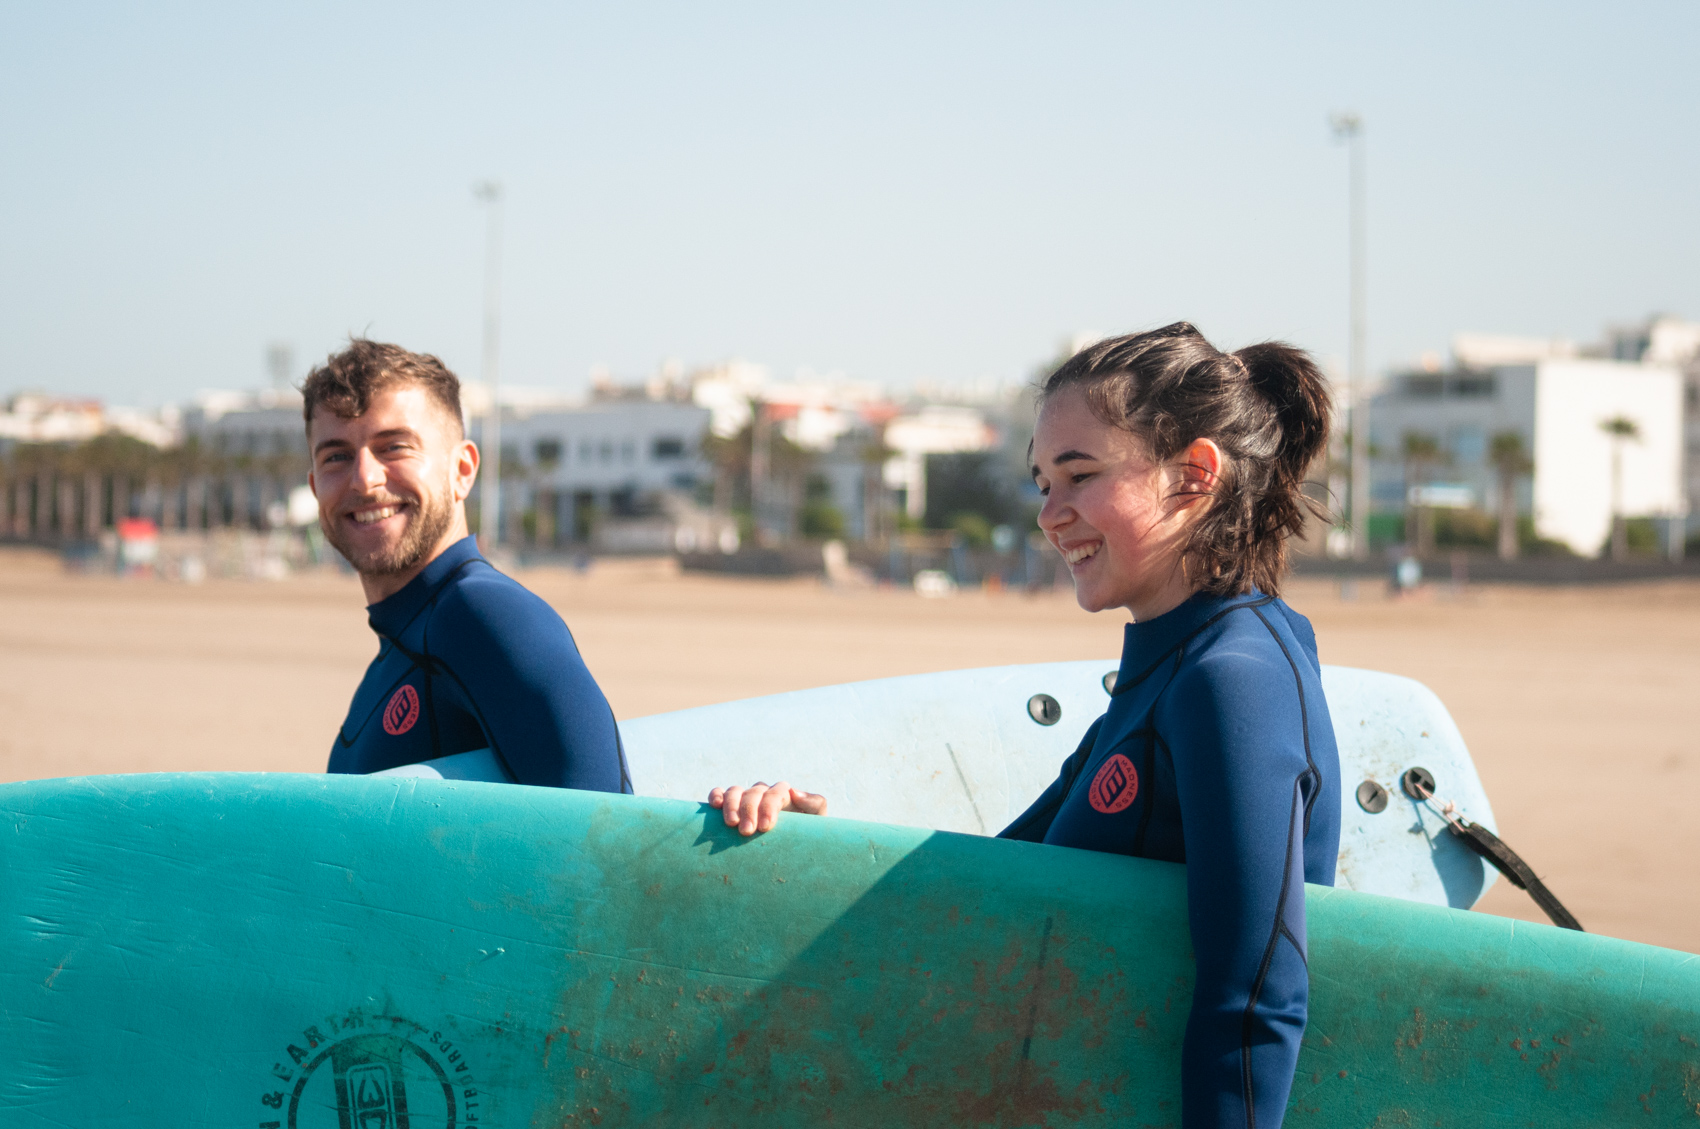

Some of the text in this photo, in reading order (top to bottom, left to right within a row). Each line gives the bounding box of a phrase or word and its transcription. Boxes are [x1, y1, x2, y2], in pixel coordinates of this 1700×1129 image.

[1115, 759, 1135, 808] MADNESS
[261, 1007, 364, 1109] & EARTH
